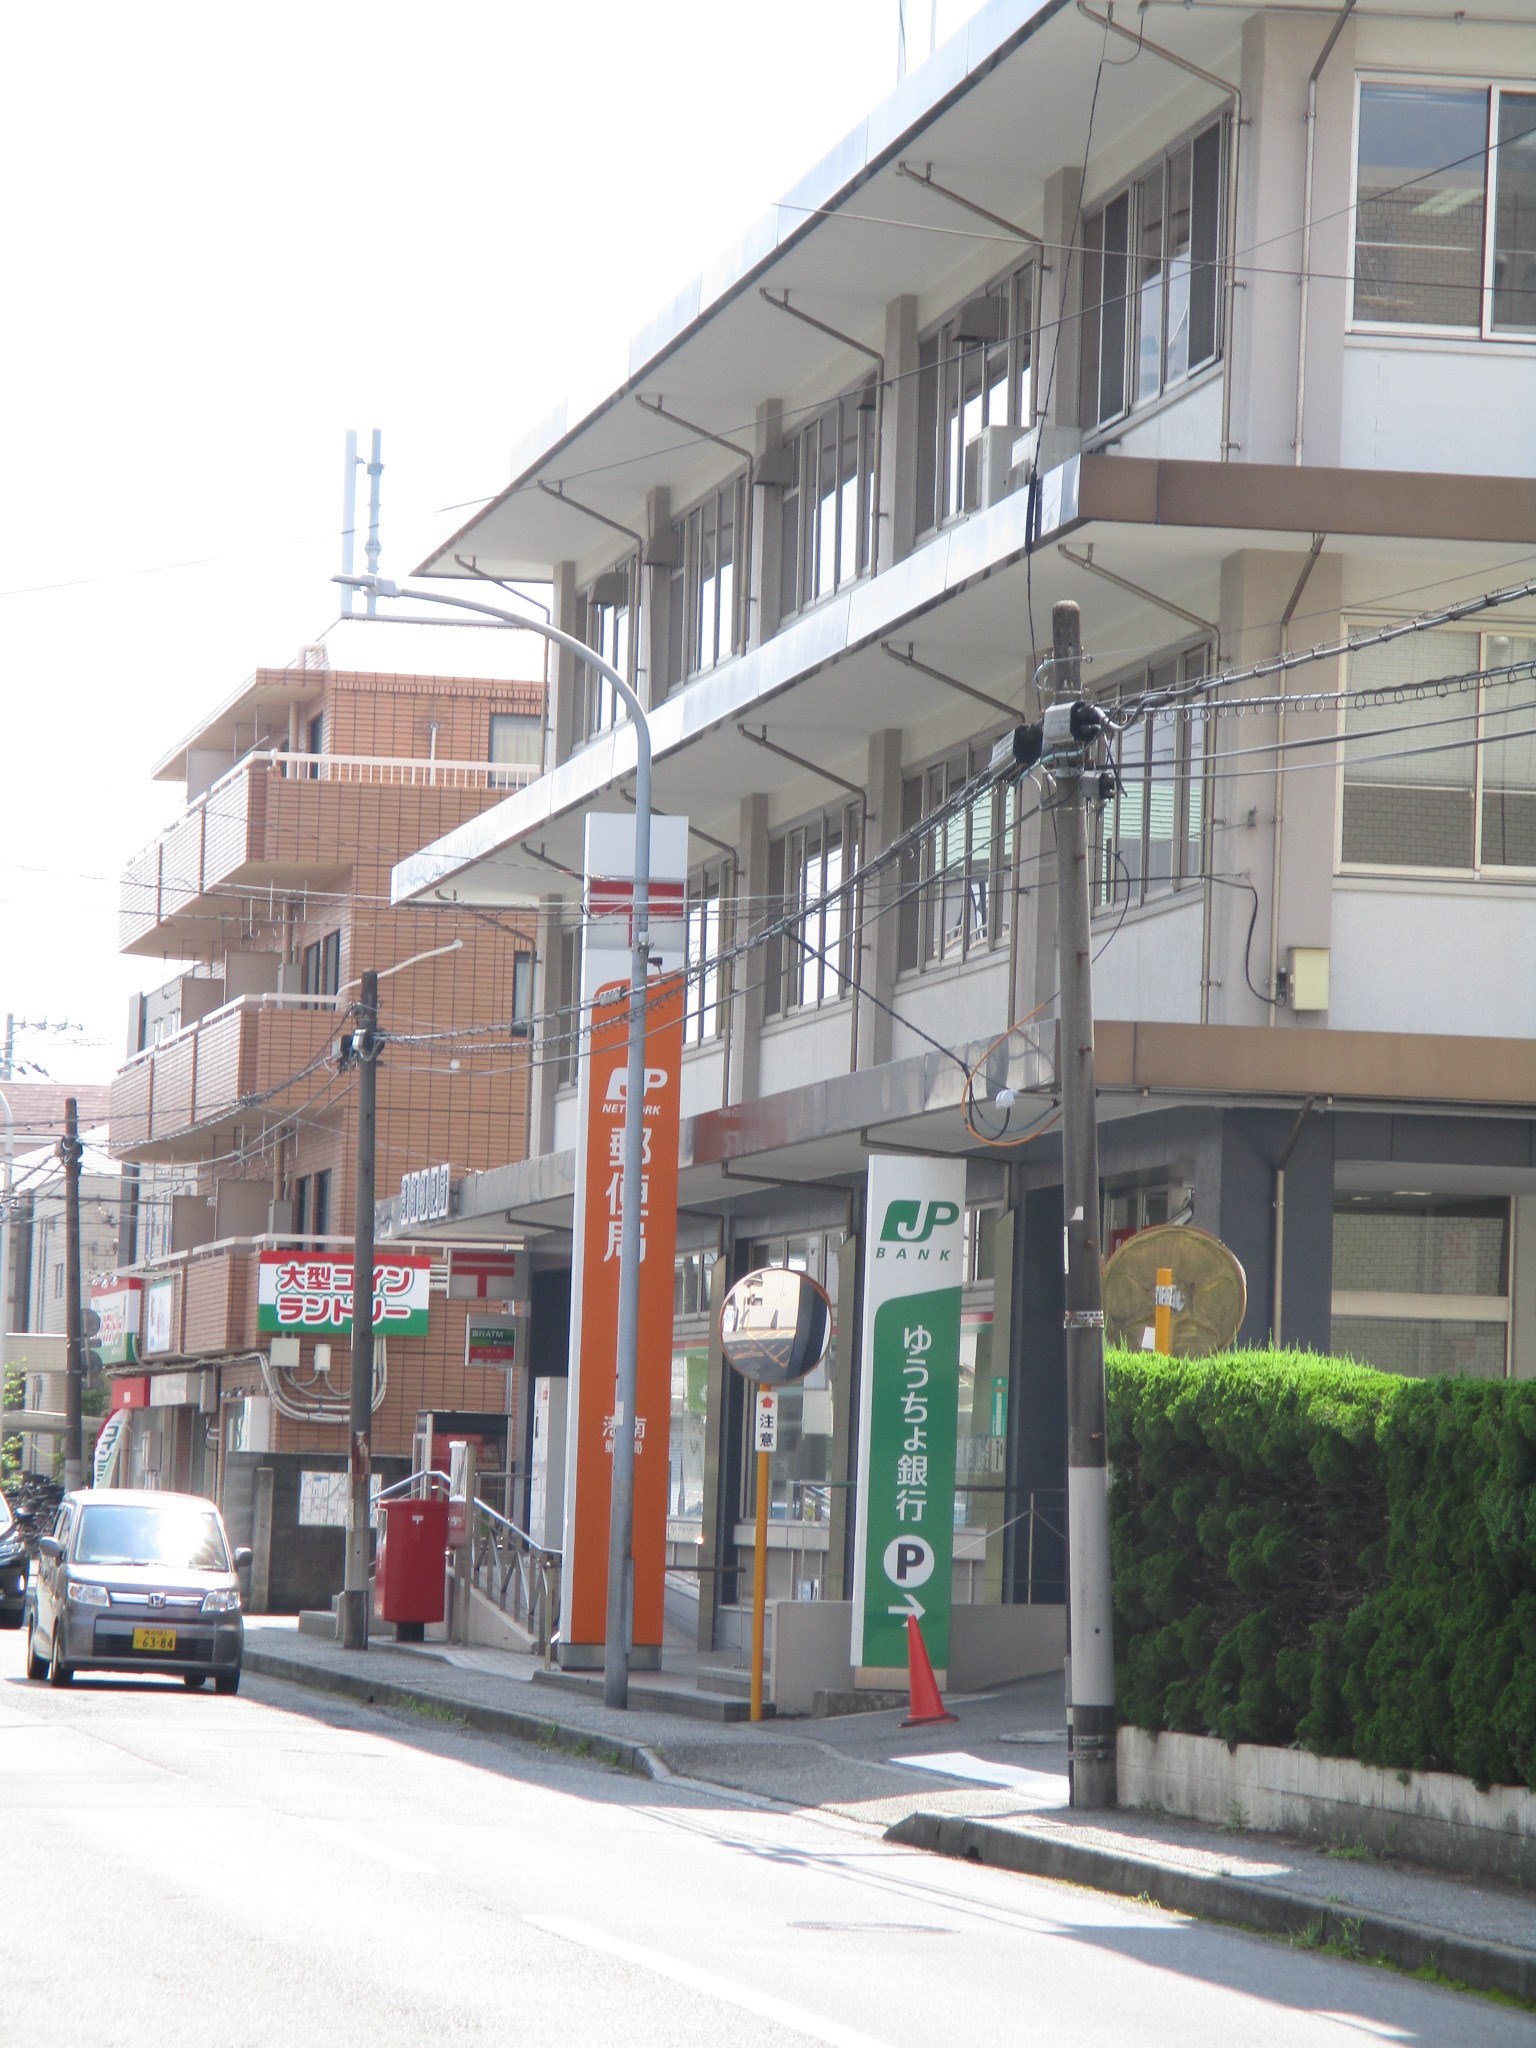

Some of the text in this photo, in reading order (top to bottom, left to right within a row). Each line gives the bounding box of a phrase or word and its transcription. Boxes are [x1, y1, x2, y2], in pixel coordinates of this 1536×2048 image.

[602, 1103, 662, 1116] NETRK
[880, 1199, 960, 1243] JP
[875, 1246, 952, 1261] BANK
[760, 1413, 775, 1447] 注意
[895, 1324, 932, 1522] ゆうちょ銀行
[896, 1543, 926, 1581] P
[142, 1636, 173, 1649] 63-84
